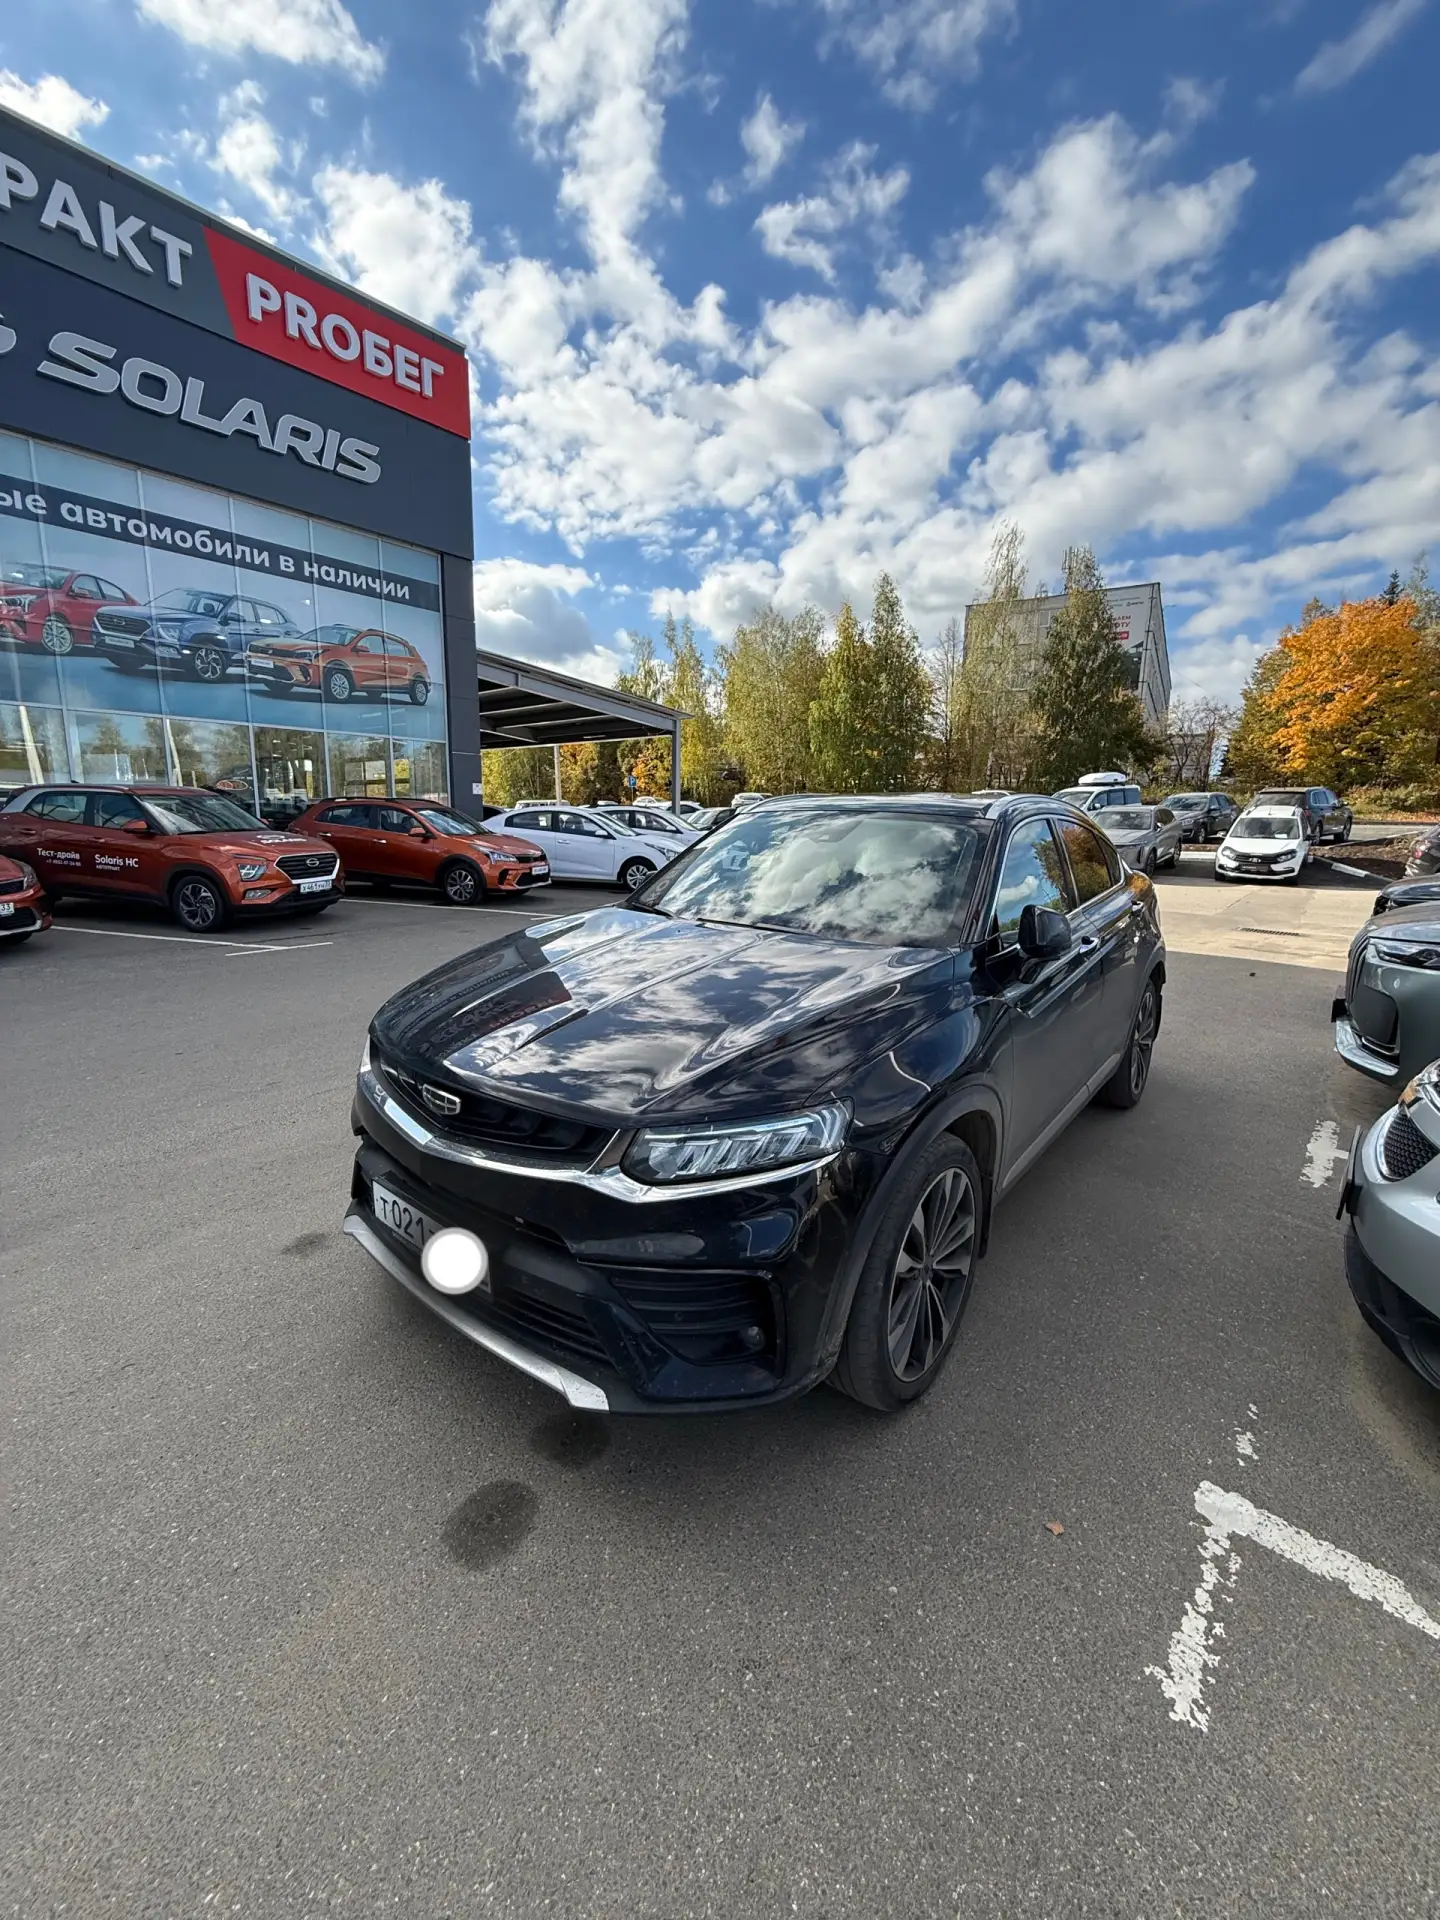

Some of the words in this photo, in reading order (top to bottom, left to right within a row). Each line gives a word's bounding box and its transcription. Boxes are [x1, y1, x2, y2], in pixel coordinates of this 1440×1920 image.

[0, 152, 193, 288] РАКТ
[246, 272, 444, 399] PROБЕГ
[36, 331, 381, 484] SOLARIS
[60, 502, 270, 567] автомобили
[279, 555, 296, 573] в
[303, 561, 410, 600] наличии
[37, 848, 80, 860] Тест-драйв
[95, 854, 123, 866] Solaris
[125, 857, 139, 868] HC
[380, 1196, 437, 1246] Т021
